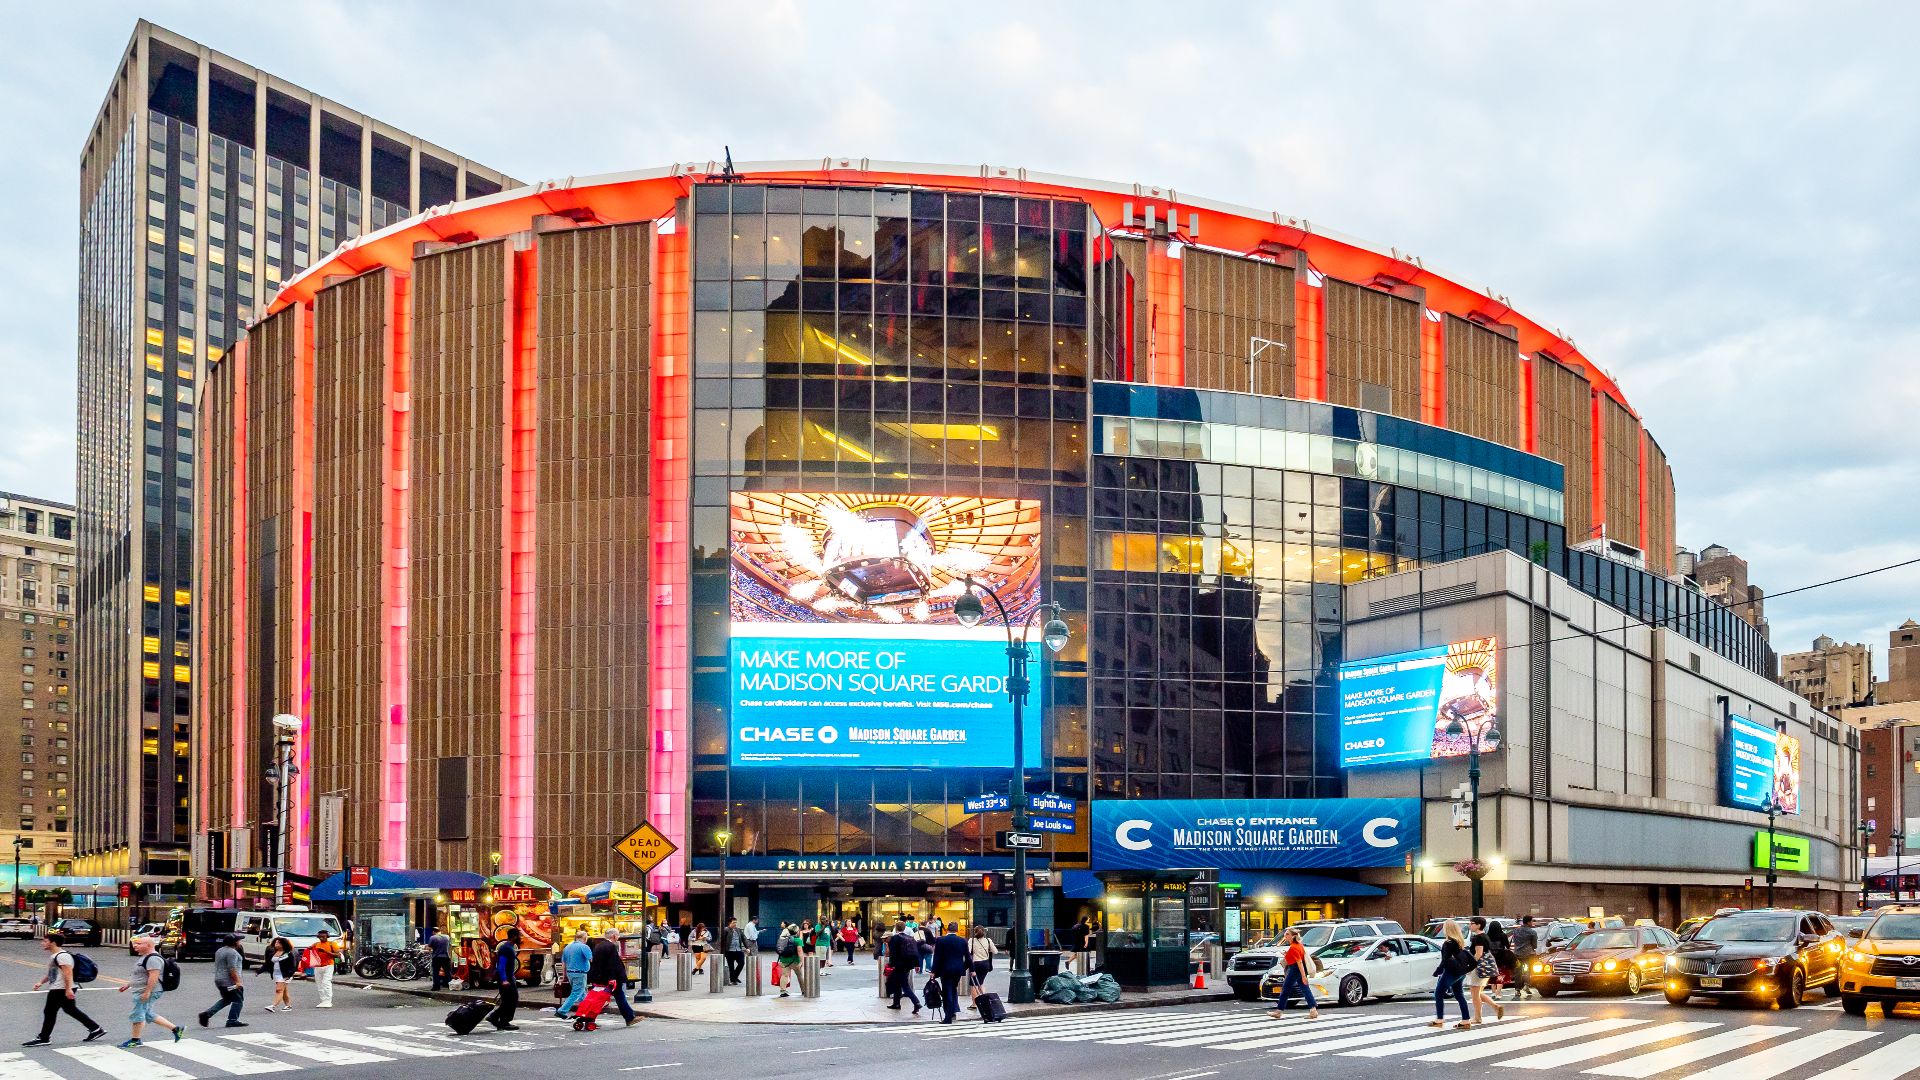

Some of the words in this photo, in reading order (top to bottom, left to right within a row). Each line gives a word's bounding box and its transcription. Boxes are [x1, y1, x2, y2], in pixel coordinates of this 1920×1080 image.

[740, 650, 800, 669] MAKE
[806, 651, 871, 669] MORE
[875, 652, 906, 670] OF
[740, 672, 842, 691] MADISON
[848, 674, 936, 694] SQUARE
[941, 675, 1029, 693] GARDE
[1344, 691, 1363, 701] MAKE
[1364, 688, 1384, 698] MORE
[1385, 687, 1395, 695] OF
[1344, 698, 1376, 709] MADISON
[1377, 693, 1404, 705] SQUARE
[1406, 688, 1436, 700] GARDEN
[740, 699, 763, 707] Chase
[740, 726, 815, 742] CHASE
[848, 727, 891, 741] MADISON
[893, 727, 928, 742] SQUARE
[930, 728, 966, 741] GARDEN
[1344, 739, 1374, 751] CHASE
[967, 800, 984, 810] West
[985, 798, 998, 808] 33rd
[999, 798, 1007, 807] St
[1033, 798, 1056, 810] Eighth
[1057, 800, 1072, 810] Ave
[1033, 819, 1044, 828] Joe
[1045, 820, 1061, 829] Louis
[1197, 818, 1234, 826] CHASE
[1250, 817, 1317, 825] ENTRANCE
[1115, 819, 1152, 850] C
[1173, 828, 1232, 846] MADISON
[1236, 827, 1285, 847] SQUARE
[1288, 827, 1338, 845] GARDEN
[1362, 817, 1399, 848] C
[629, 838, 661, 847] DEAD
[634, 850, 657, 859] END
[778, 860, 897, 870] PENNSYLVANIA
[904, 860, 967, 870] STATION
[452, 890, 463, 901] HOT
[464, 890, 475, 901] DOG
[492, 889, 536, 901] ALAFEL
